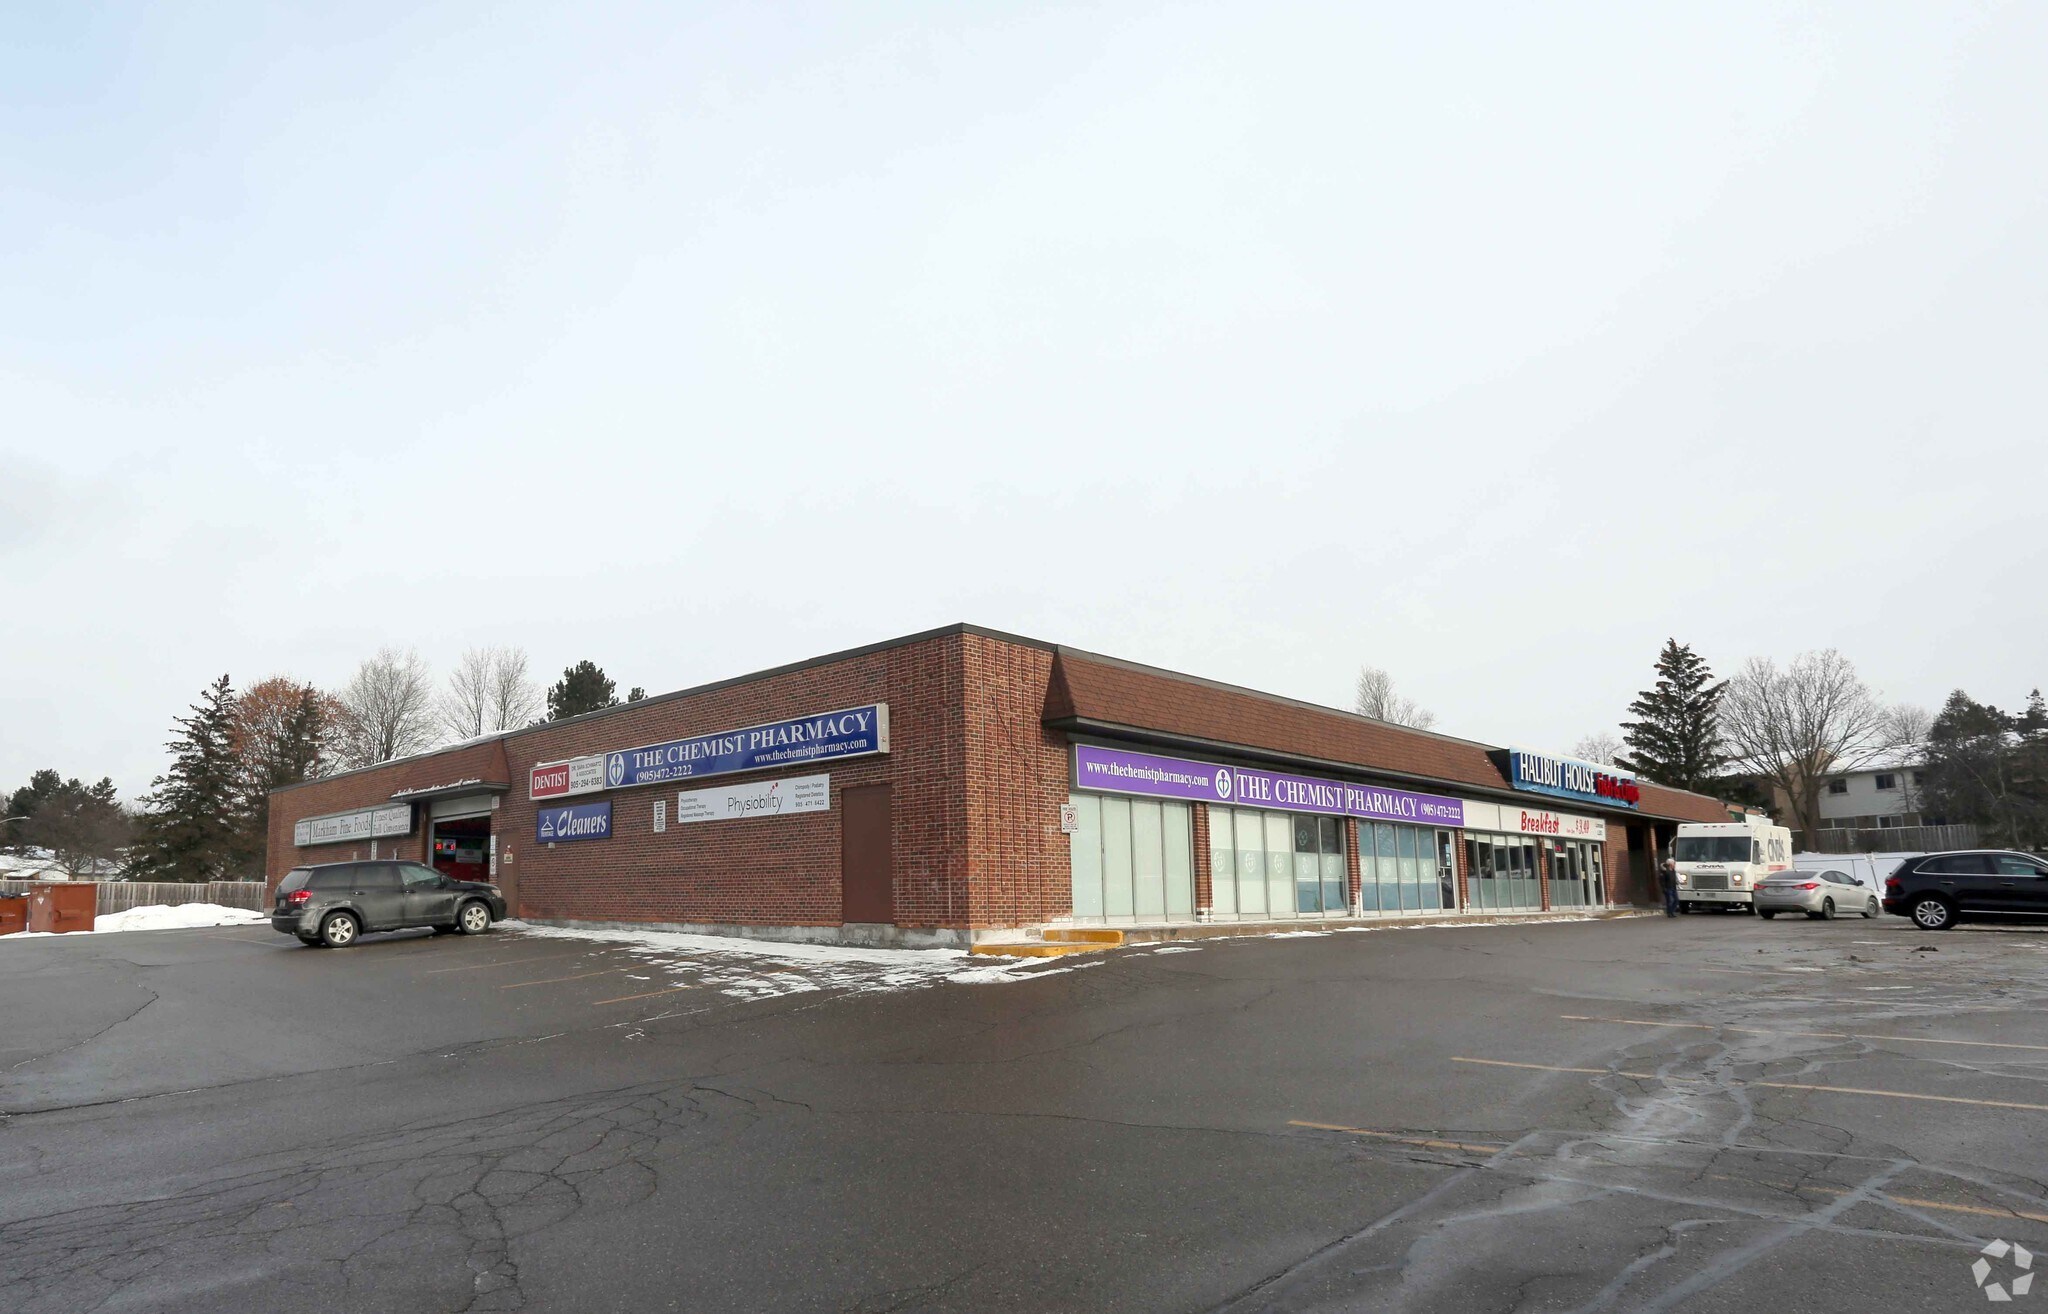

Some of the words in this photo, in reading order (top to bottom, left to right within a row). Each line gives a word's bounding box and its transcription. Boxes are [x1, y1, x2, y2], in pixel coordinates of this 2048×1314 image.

[633, 749, 664, 769] THE
[667, 734, 745, 763] CHEMIST
[749, 711, 872, 751] PHARMACY
[754, 738, 868, 763] www.thechemistpharmacy.com
[534, 771, 567, 790] DENTIST
[636, 764, 693, 784] (905)472-2222
[1086, 762, 1209, 788] www.thechemistpharmacy.com
[1520, 752, 1562, 787] HALIBUT
[1565, 763, 1596, 793] HOUSE
[727, 793, 783, 816] Physiobility
[1237, 774, 1271, 800] THE
[1275, 780, 1343, 808] CHEMIST
[1347, 788, 1417, 817] PHARMACY
[312, 822, 338, 838] Markham
[340, 819, 352, 835] Fine
[354, 815, 371, 832] Foods
[557, 810, 607, 837] Cleaners
[1521, 811, 1560, 834] Breakfast
